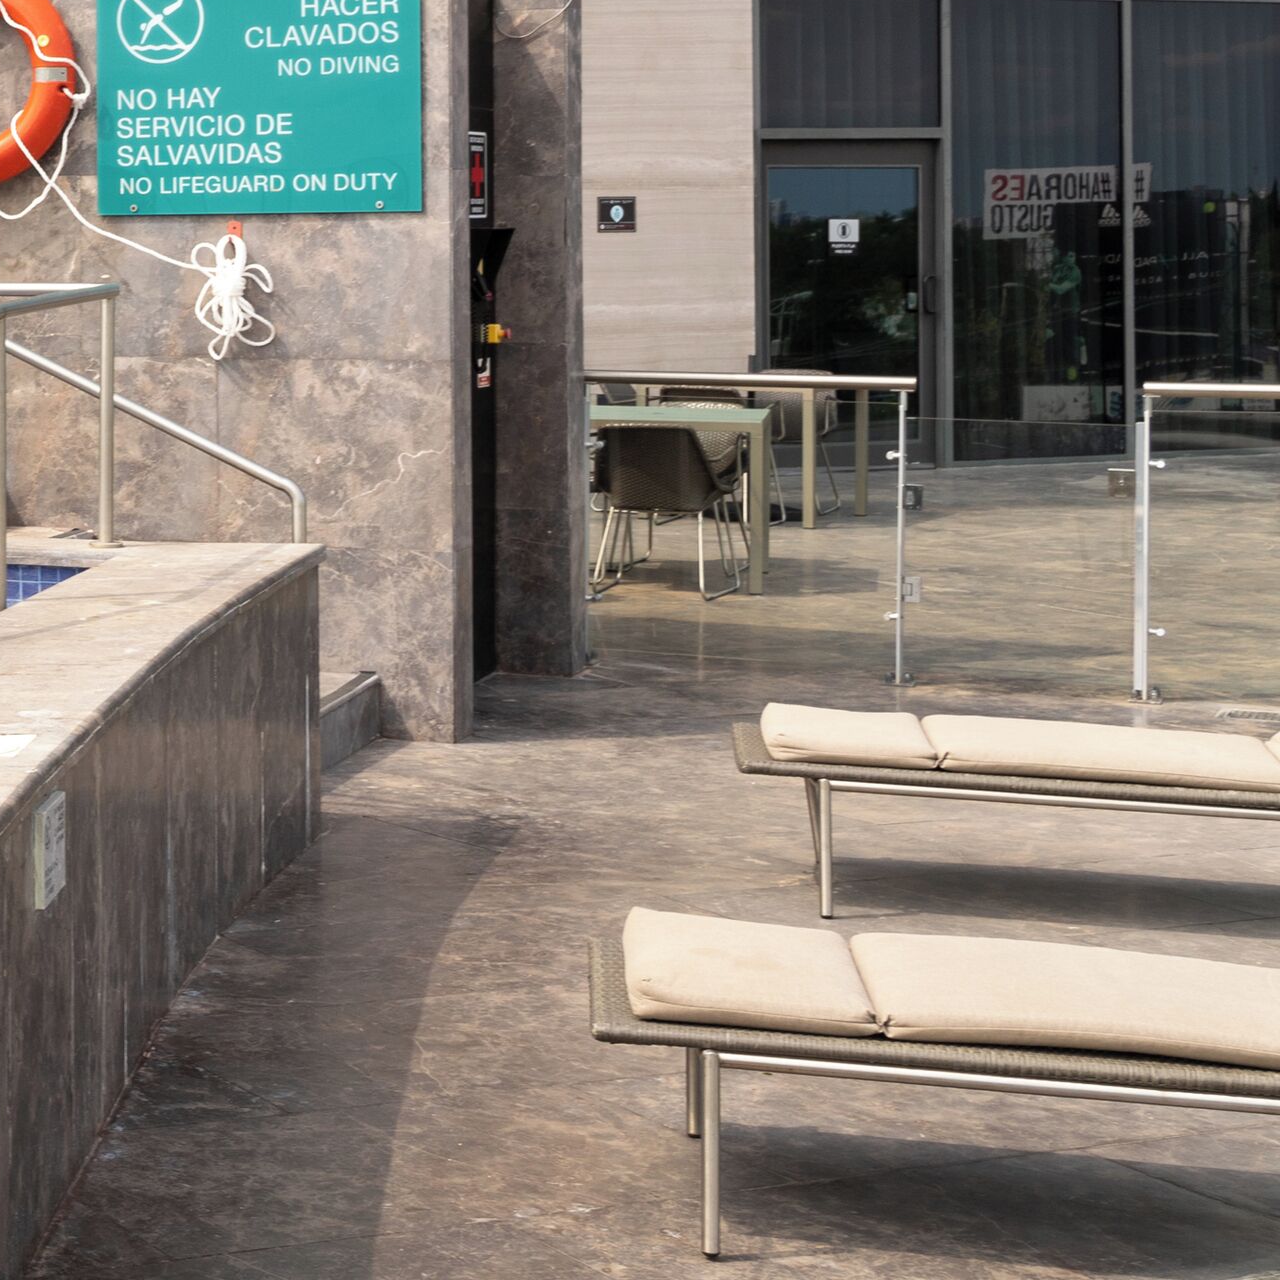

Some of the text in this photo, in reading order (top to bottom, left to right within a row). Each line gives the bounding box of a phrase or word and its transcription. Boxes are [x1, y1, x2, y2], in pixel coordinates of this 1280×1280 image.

[244, 21, 399, 48] CLAVADOS
[277, 54, 400, 76] NO DIVING
[116, 86, 222, 110] NO HAY
[116, 113, 293, 139] SERVICIO DE
[116, 142, 282, 167] SALVAVIDAS
[119, 172, 398, 195] NO LIFEGUARD ON DUTY
